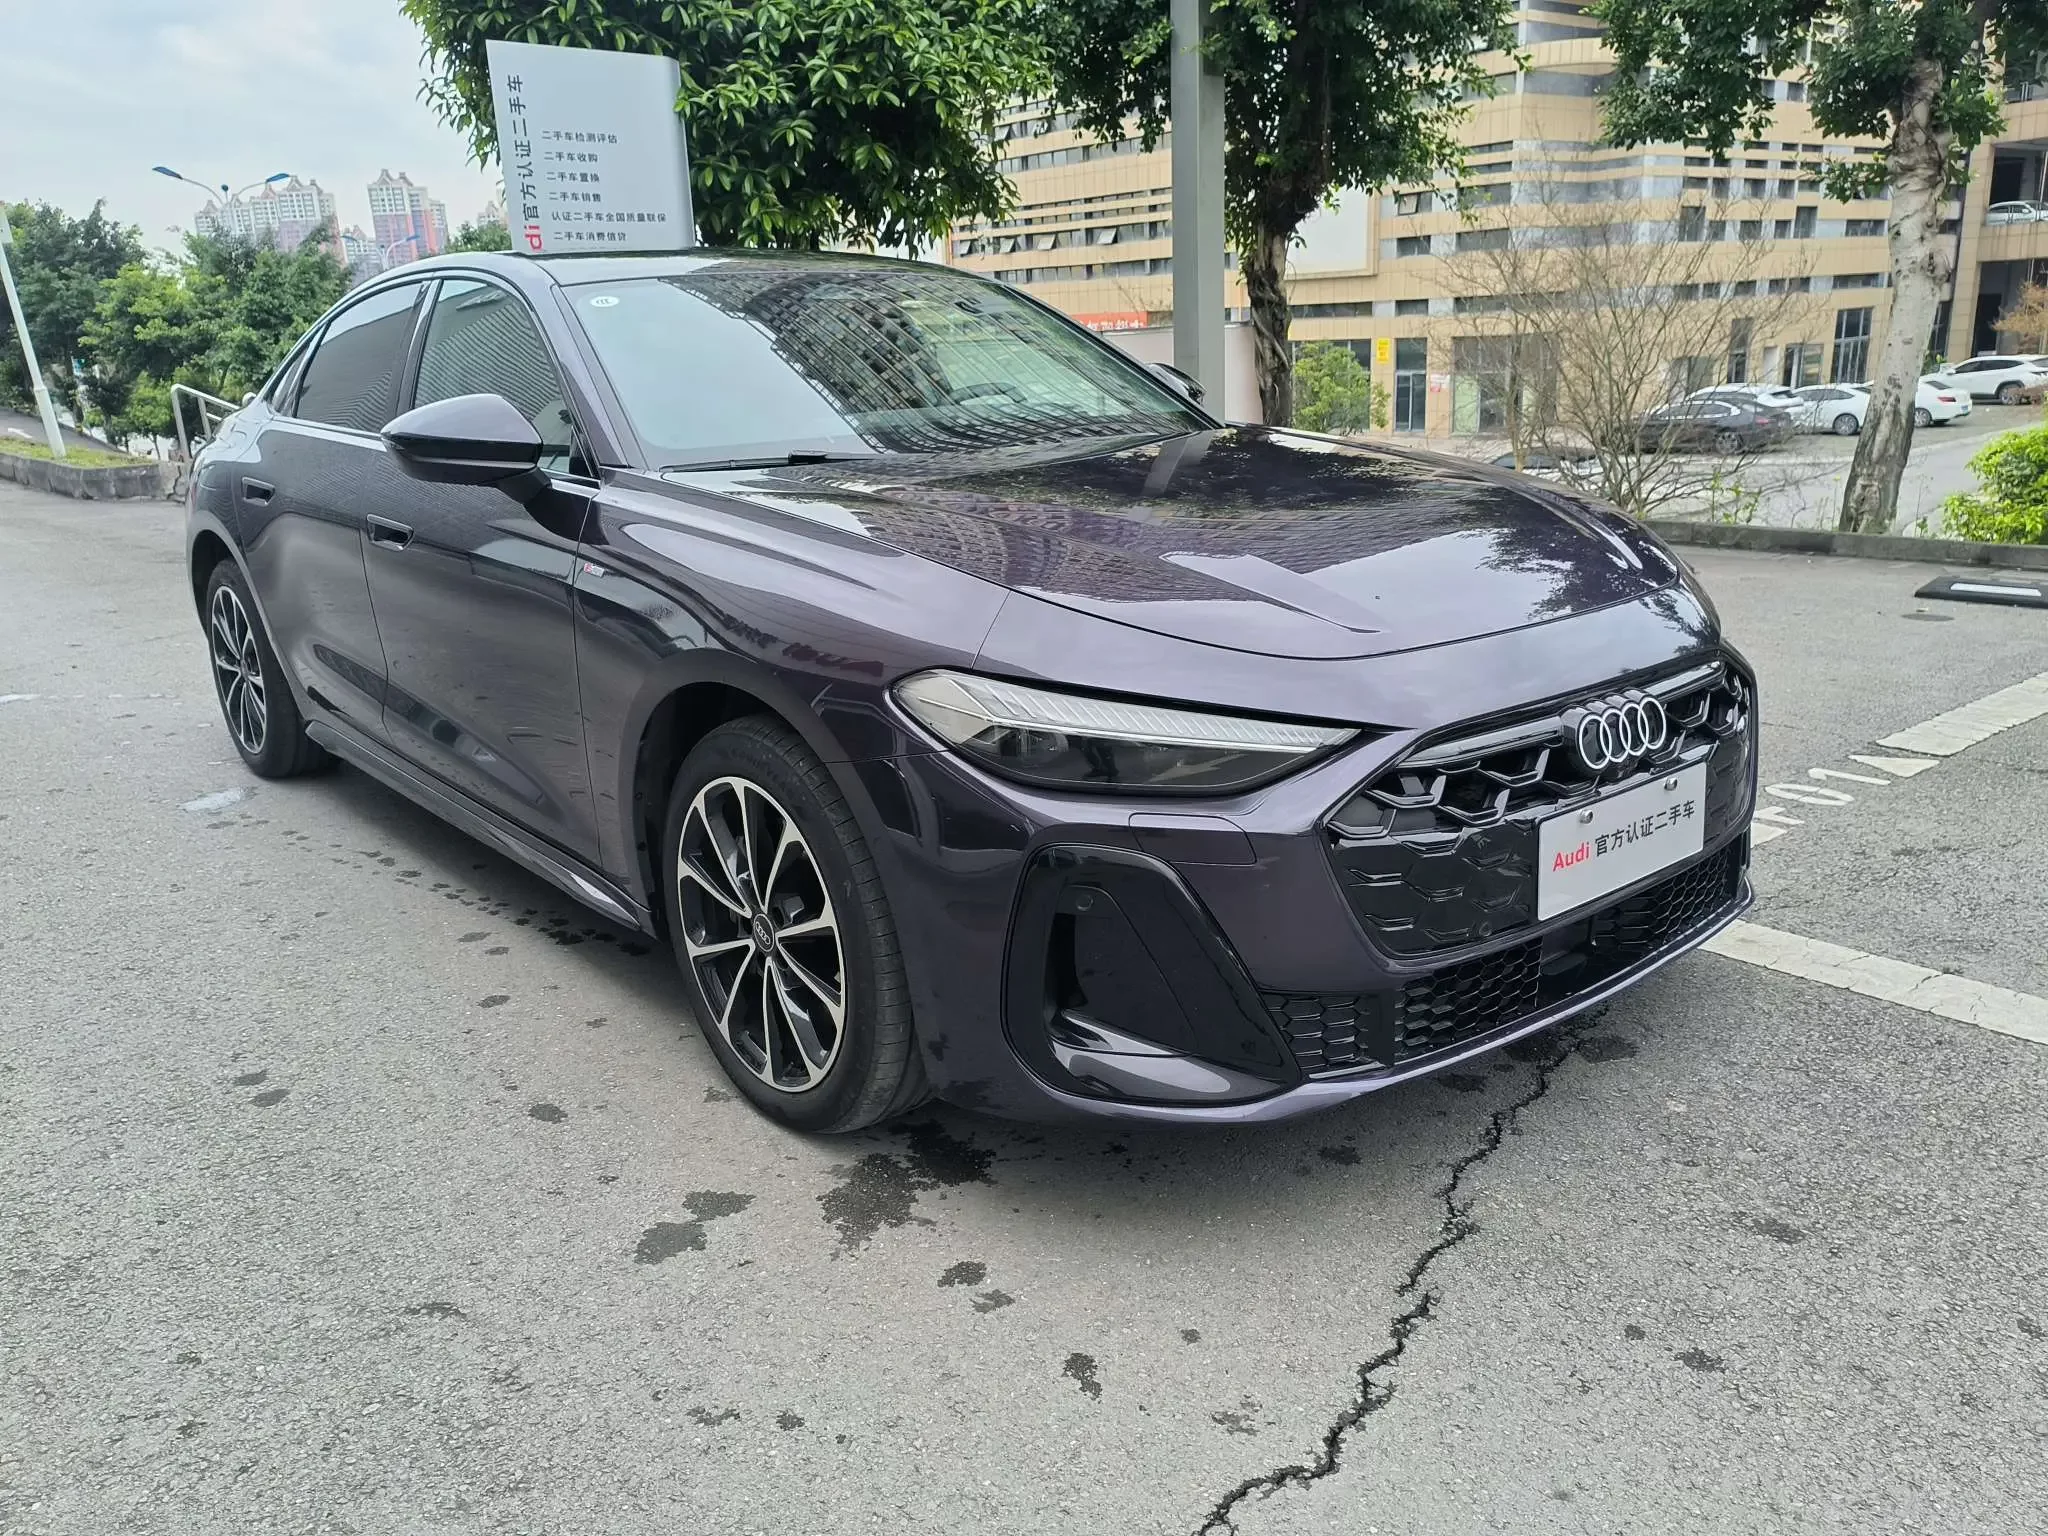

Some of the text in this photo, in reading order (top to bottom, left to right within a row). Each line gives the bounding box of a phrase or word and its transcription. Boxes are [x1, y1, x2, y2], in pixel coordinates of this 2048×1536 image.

[541, 130, 618, 144] 二手车检测评估
[506, 74, 540, 221] 官方认证二手车
[543, 151, 599, 163] 二手车收购
[546, 171, 600, 183] 二手车置换
[548, 191, 602, 203] 二手车销售
[551, 211, 667, 223] 认证二手车全国质量联保
[553, 231, 627, 242] 二手车消费信贷
[1552, 799, 1695, 872] Audi 官方认证二手车
